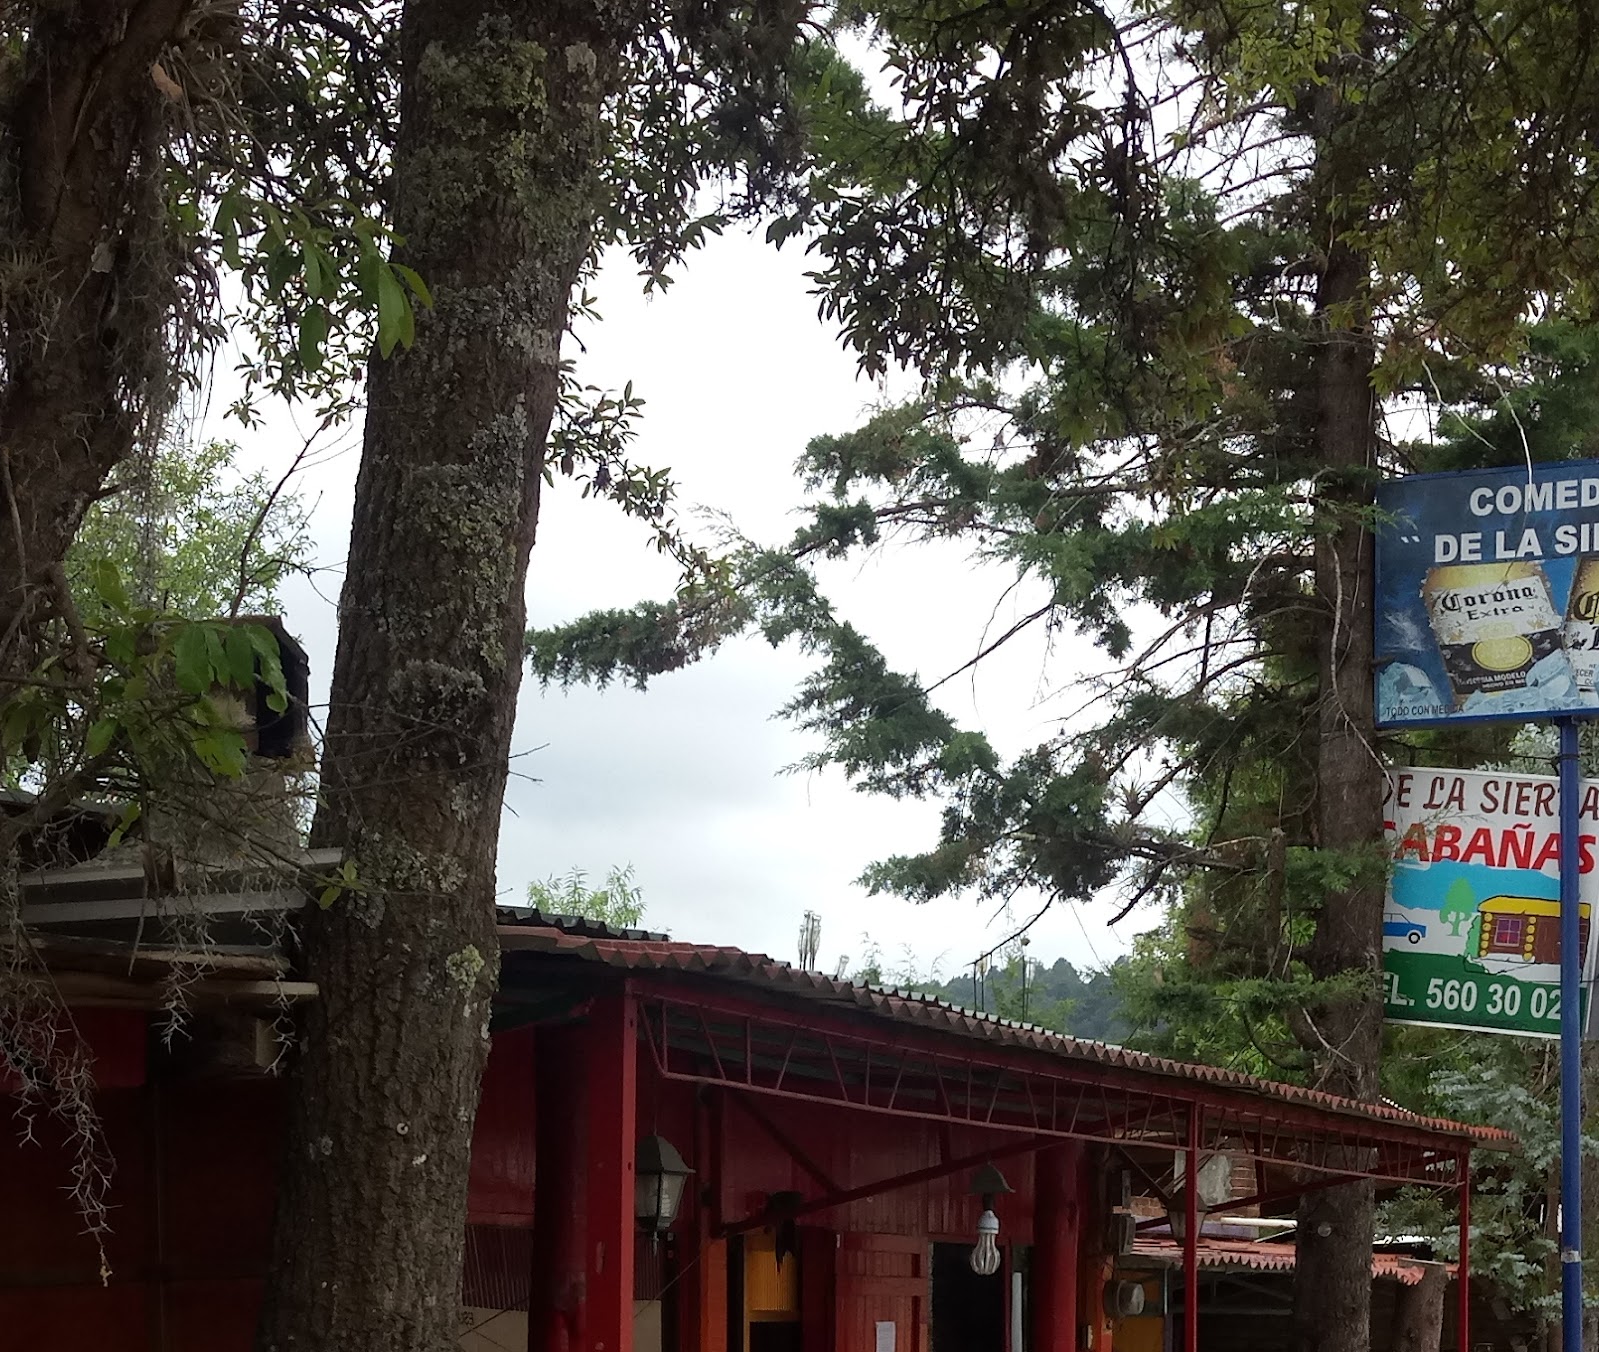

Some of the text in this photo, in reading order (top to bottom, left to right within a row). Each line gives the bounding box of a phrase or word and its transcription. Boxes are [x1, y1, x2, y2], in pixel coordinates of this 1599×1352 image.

[1434, 532, 1483, 564] DE
[1495, 528, 1542, 560] LA
[1441, 586, 1534, 614] Corona
[1467, 603, 1525, 621] Extra
[1423, 776, 1465, 812] LA
[1480, 780, 1599, 821] SIERA
[1383, 820, 1597, 874] ABAÑAS
[1426, 978, 1478, 1012] 560
[1486, 983, 1521, 1016] 30
[1530, 987, 1562, 1020] 02
